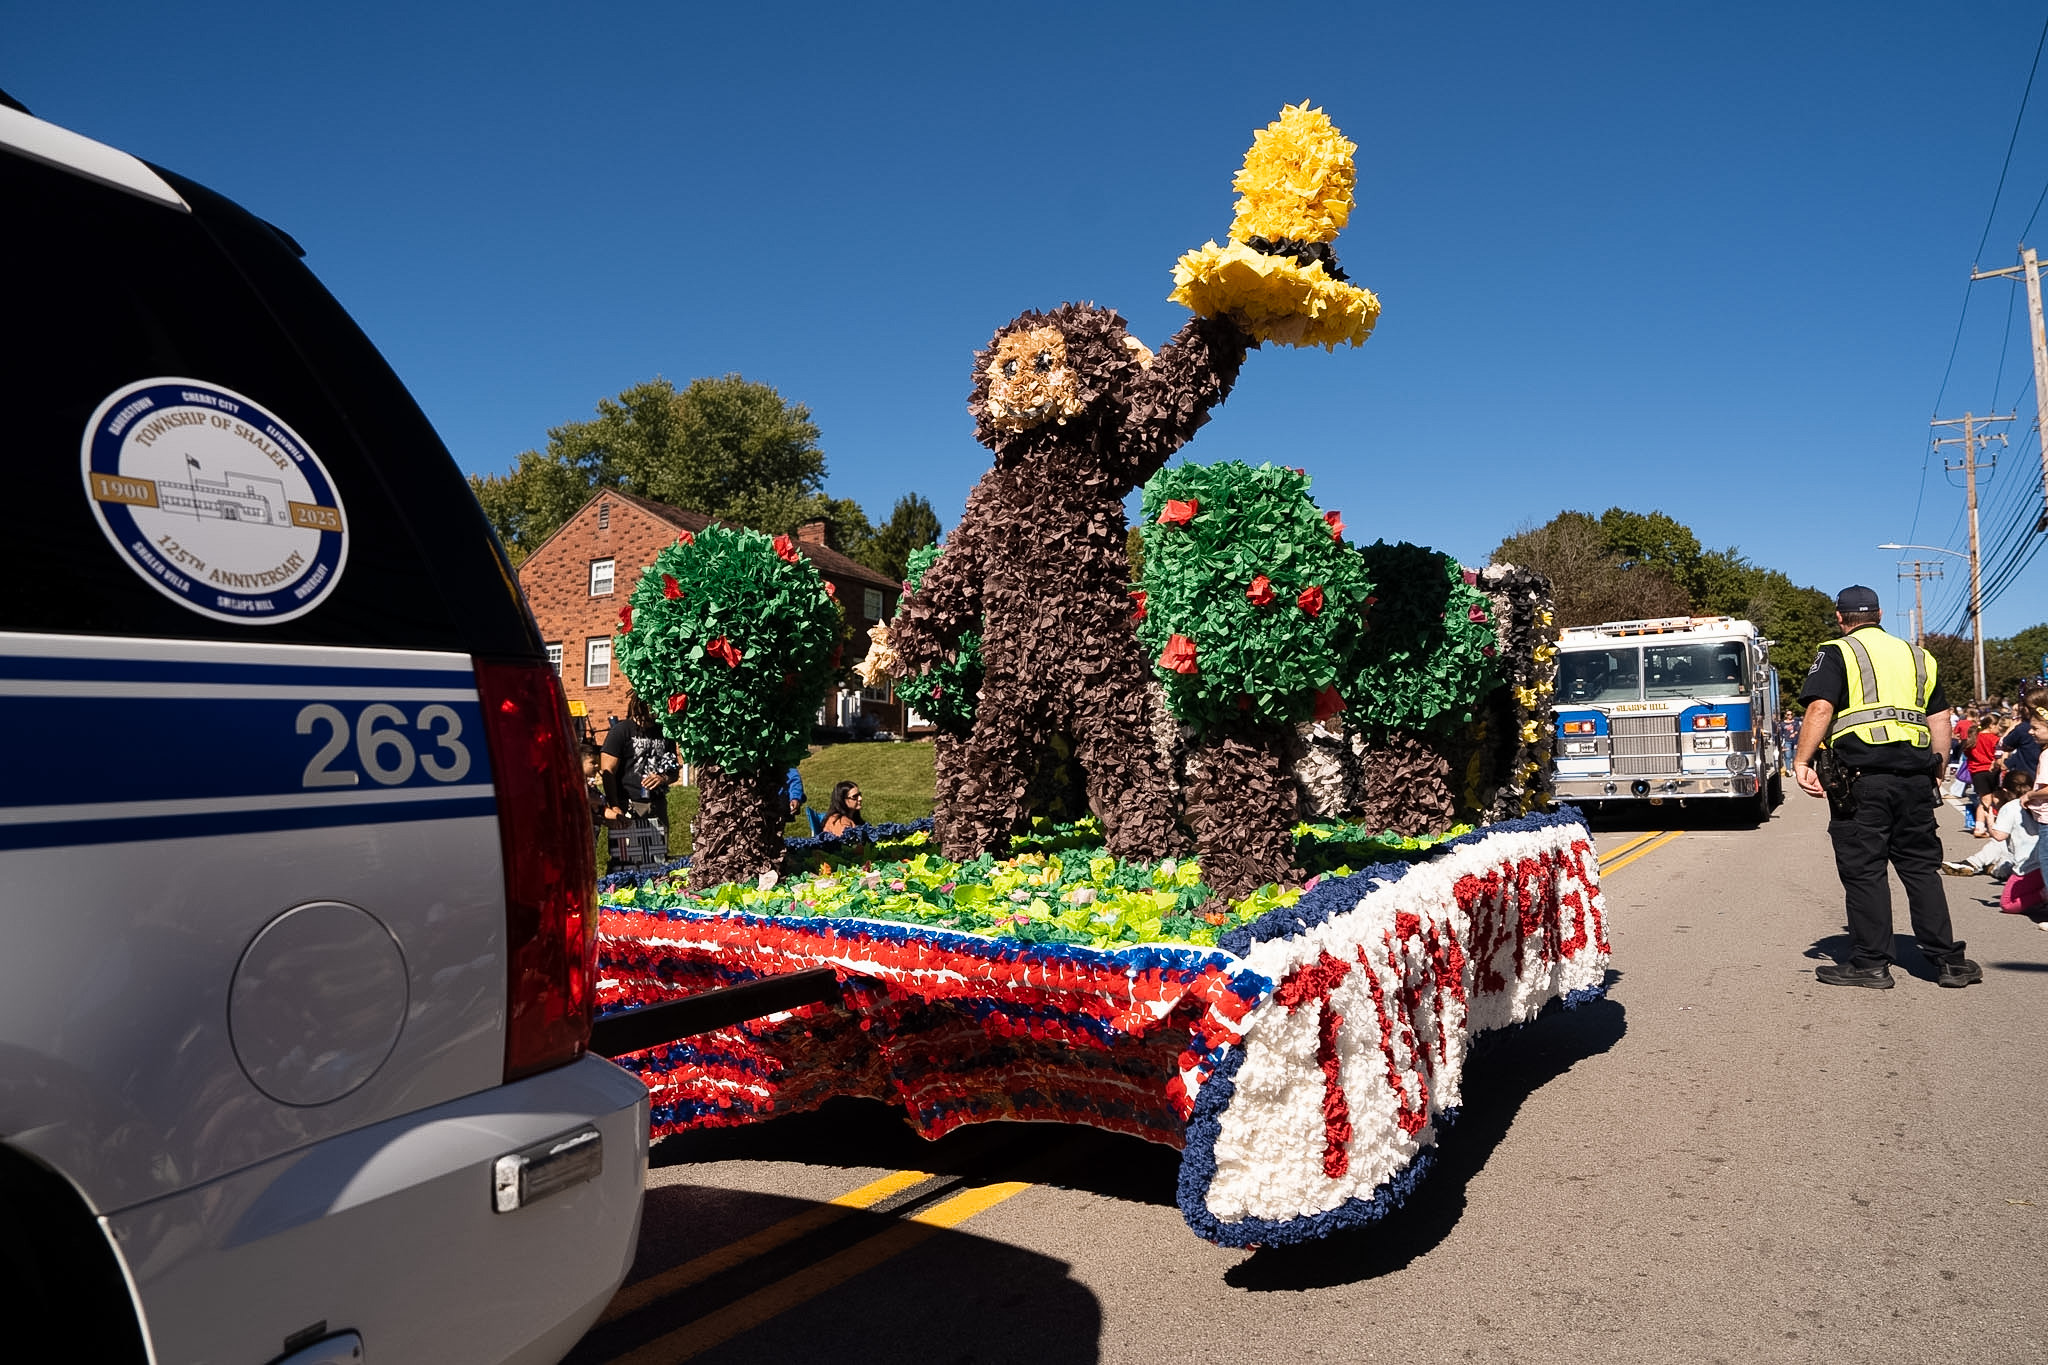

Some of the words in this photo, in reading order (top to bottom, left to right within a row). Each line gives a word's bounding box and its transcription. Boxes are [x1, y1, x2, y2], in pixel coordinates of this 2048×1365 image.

[218, 398, 239, 413] CITY
[135, 411, 206, 447] TOWNSHIP
[211, 415, 232, 430] OF
[234, 424, 289, 470] SHALER
[100, 479, 148, 500] 1900
[297, 508, 337, 527] 2025
[209, 550, 305, 588] ANNIVERSARY
[163, 569, 190, 592] VILLA
[1873, 708, 1923, 722] POICE
[296, 703, 471, 787] 263
